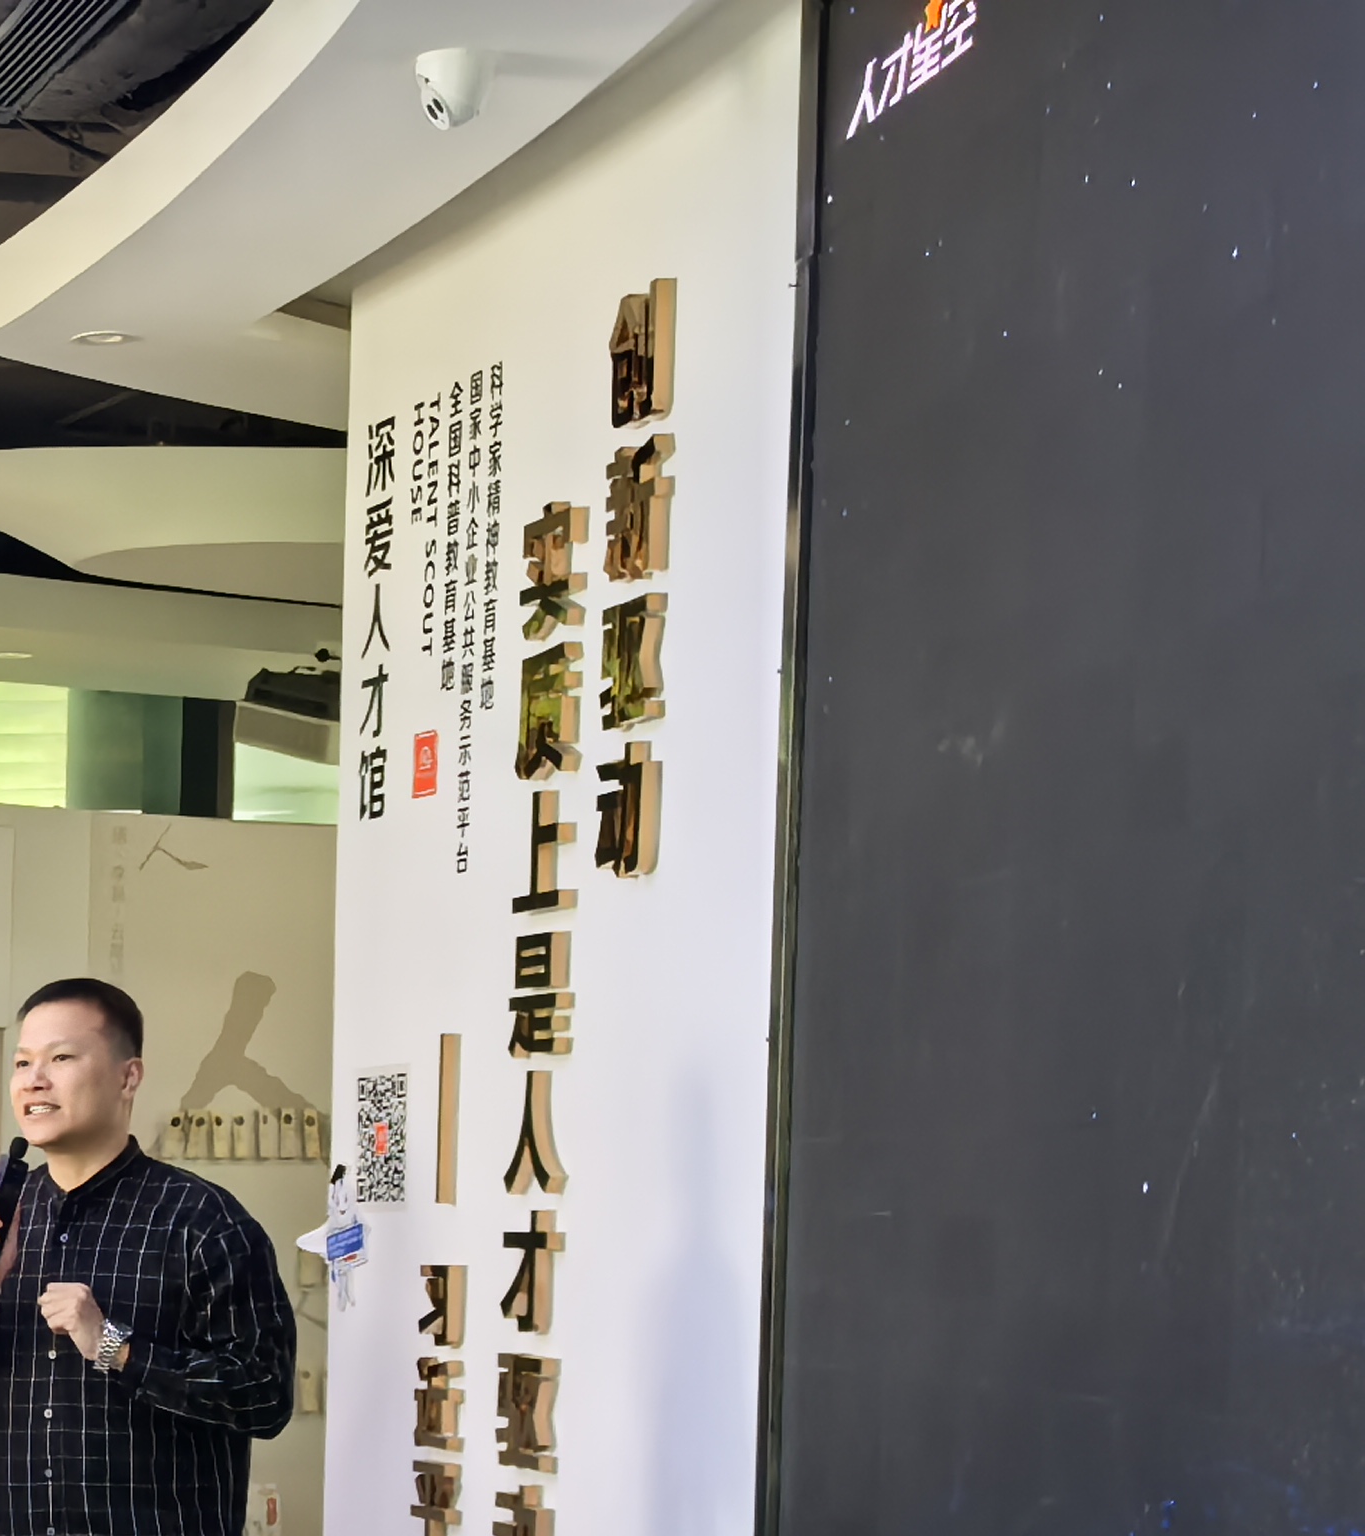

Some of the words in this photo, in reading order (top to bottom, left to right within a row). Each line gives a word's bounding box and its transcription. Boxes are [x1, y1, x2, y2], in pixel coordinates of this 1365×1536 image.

[410, 401, 425, 525] HOUSE
[421, 538, 437, 656] SCOUT
[426, 391, 442, 528] TALENT
[440, 381, 464, 692] 全国科普教育基地
[479, 361, 504, 711] 科学家精神教育基地
[358, 415, 396, 822] 深爱人才馆
[456, 370, 483, 874] 国家中小企业公共服务示范平台
